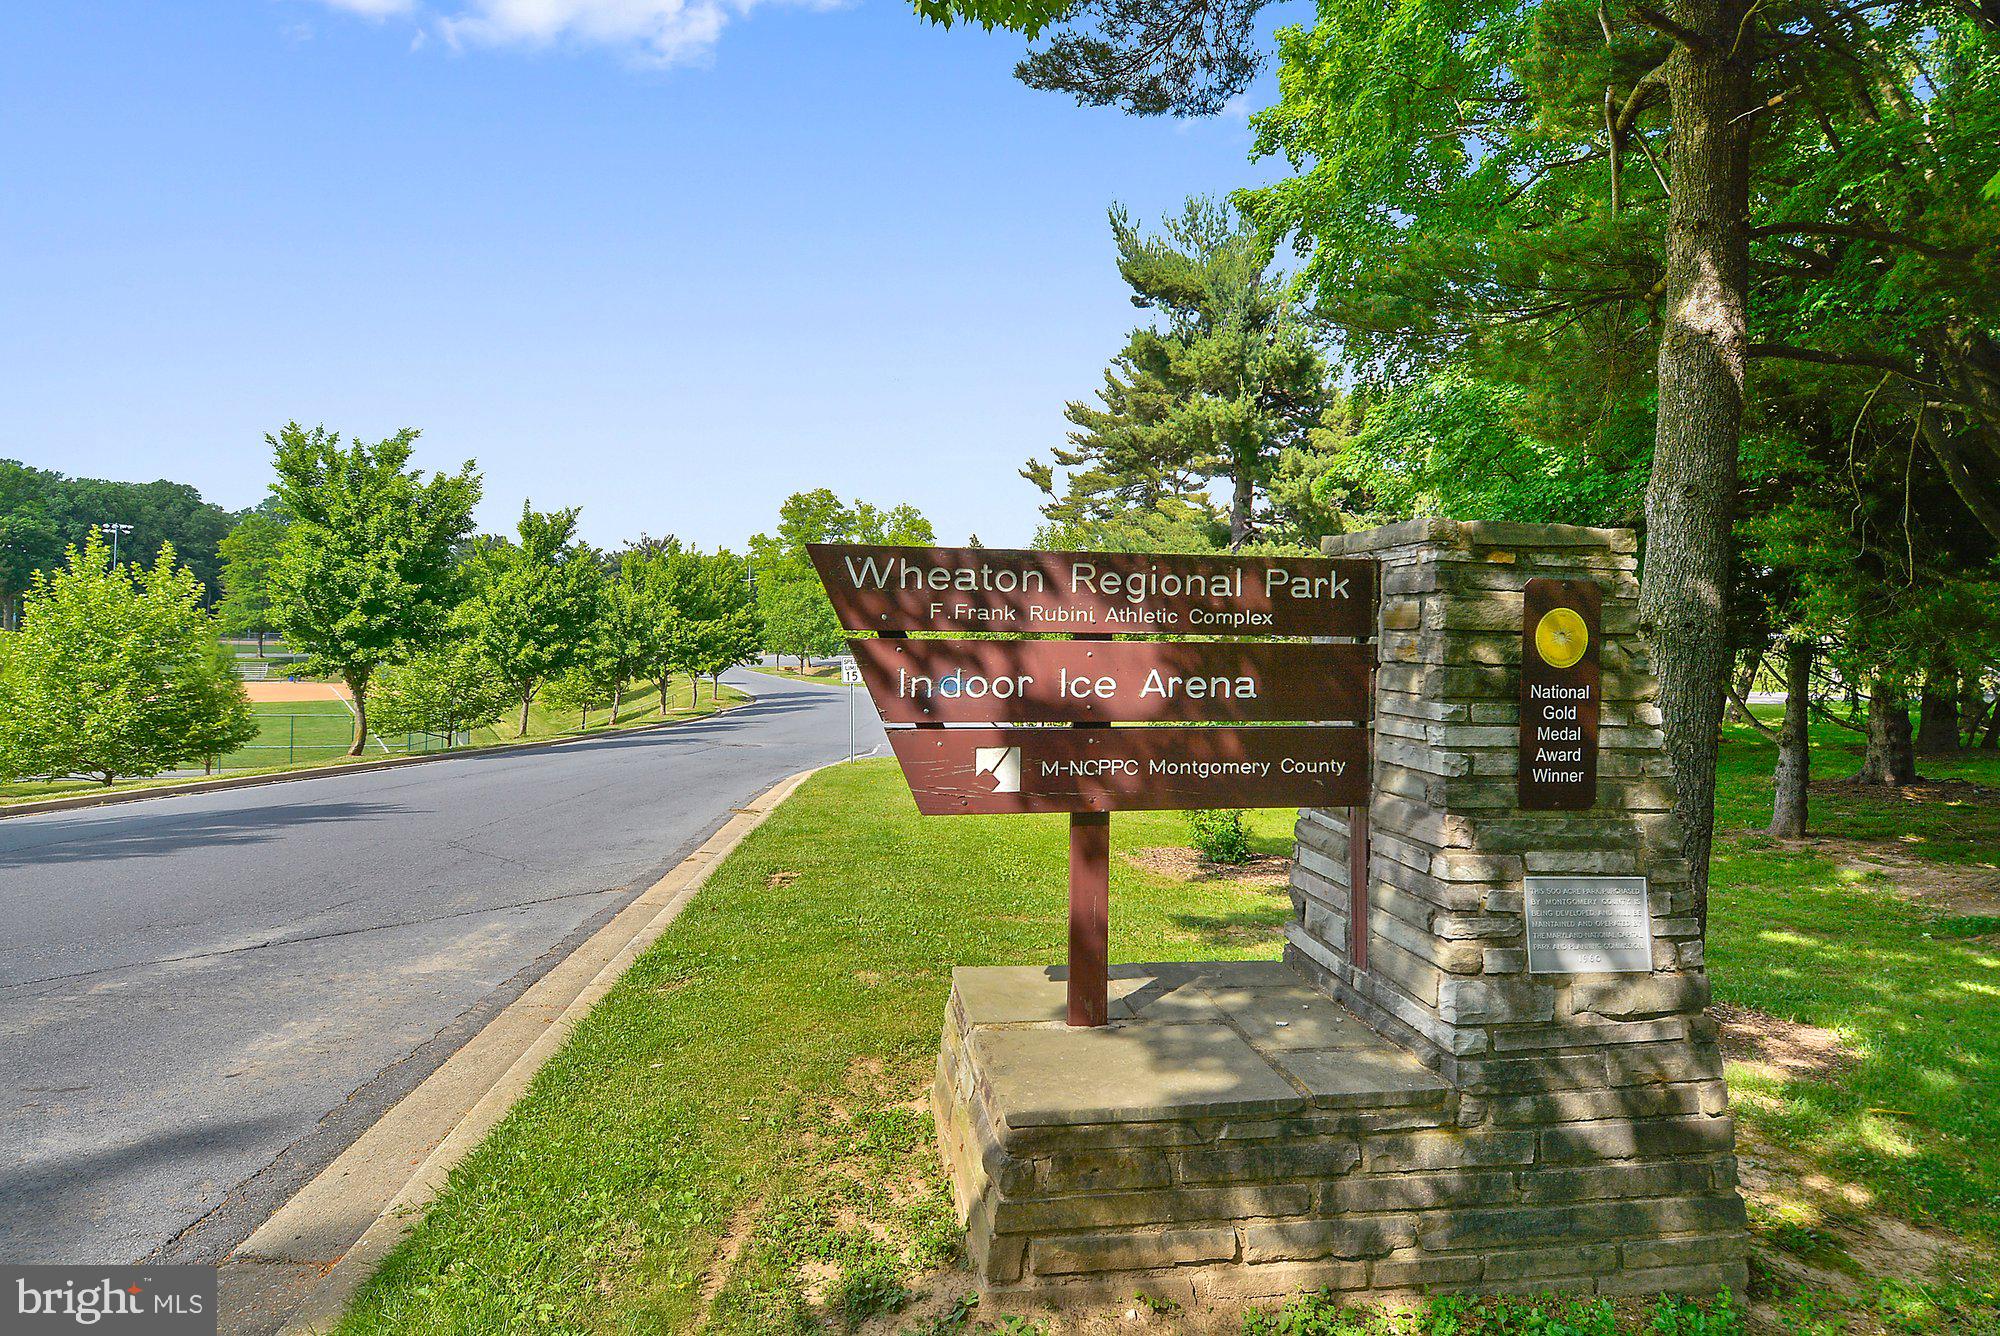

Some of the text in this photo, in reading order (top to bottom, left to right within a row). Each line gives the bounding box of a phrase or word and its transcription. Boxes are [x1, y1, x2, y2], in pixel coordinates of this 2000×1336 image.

[844, 555, 1350, 604] Wheaton Regional Park
[1029, 604, 1095, 623] Rubini
[1104, 606, 1179, 624] Athletic
[1189, 608, 1274, 628] Complex
[846, 671, 858, 681] 15
[899, 667, 1258, 699] Indoor Ice Arena
[1530, 684, 1590, 700] National
[1542, 705, 1577, 721] Gold
[1537, 726, 1582, 741] Medal
[1535, 747, 1582, 763] Award
[1041, 757, 1347, 779] M-NCPPC Montgomery County
[1532, 768, 1585, 784] Winner
[1562, 887, 1581, 895] ACRE
[1530, 898, 1541, 906] BY
[1545, 898, 1597, 906] MONTGOMERY
[1531, 909, 1553, 917] BEING
[1597, 909, 1613, 917] AND
[1531, 920, 1576, 928] MAINTAINED
[1577, 920, 1593, 928] AND
[1595, 920, 1630, 928] OPERATED
[1532, 931, 1546, 939] THE
[1533, 943, 1551, 951] PARK
